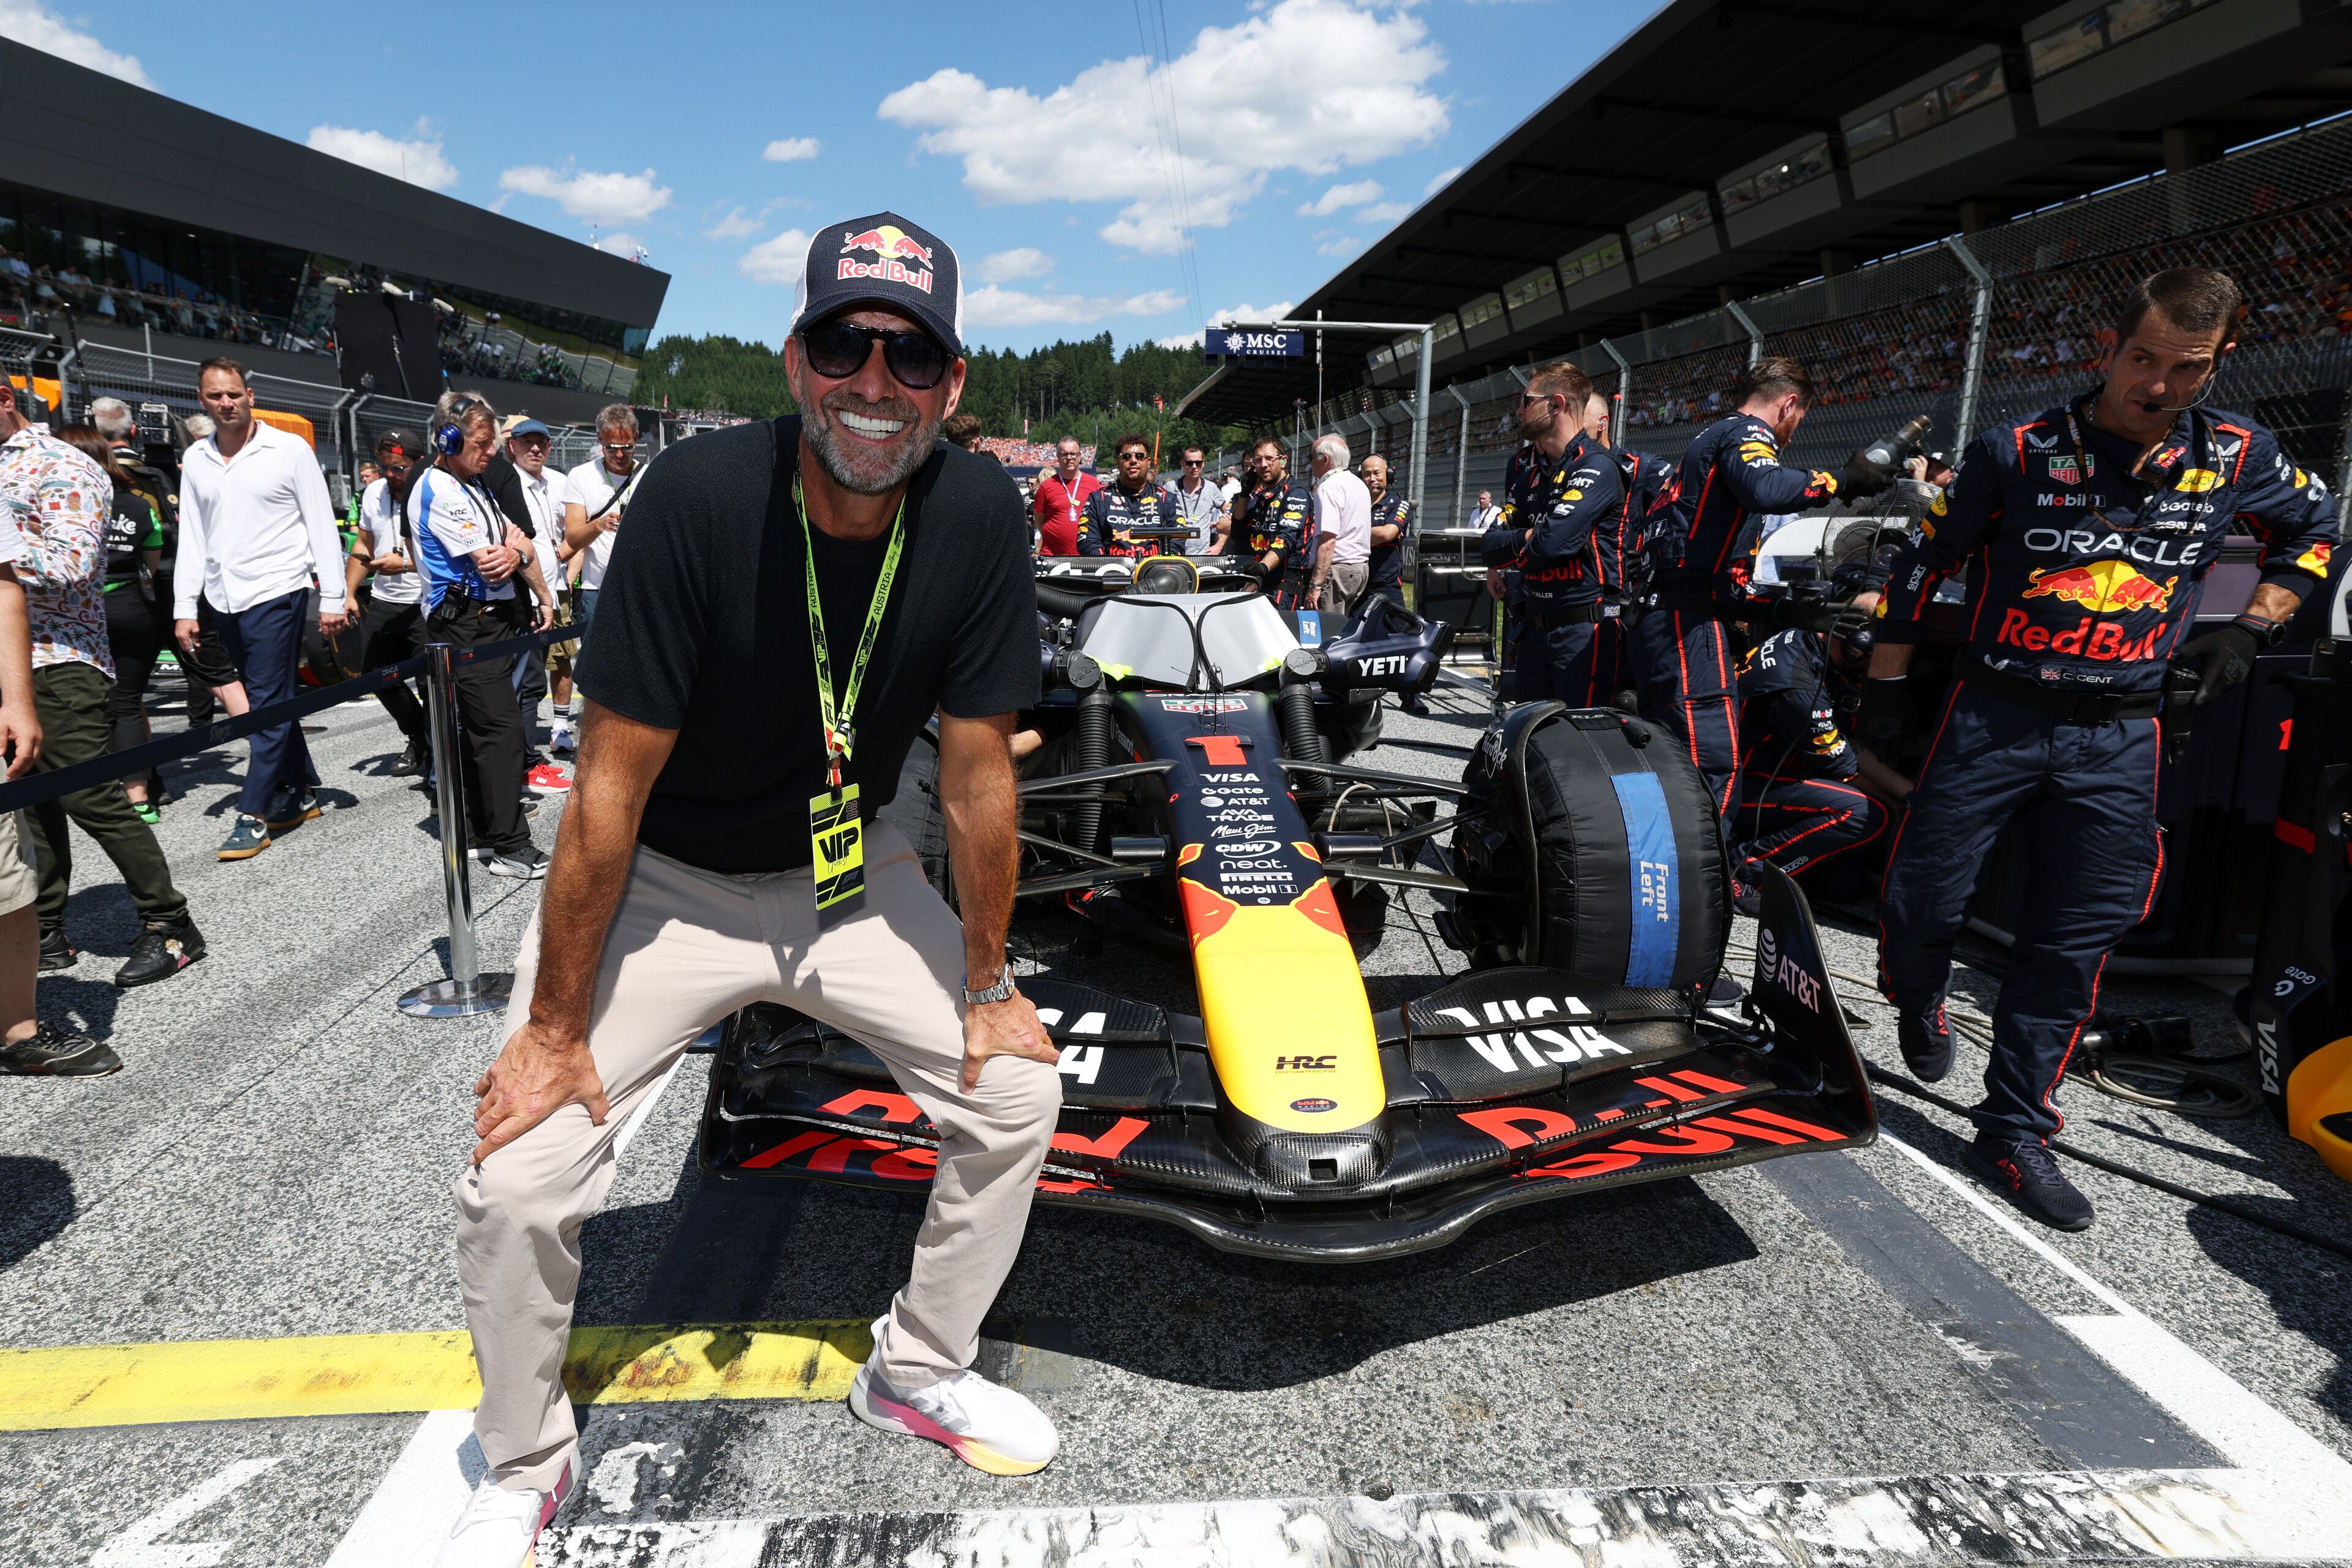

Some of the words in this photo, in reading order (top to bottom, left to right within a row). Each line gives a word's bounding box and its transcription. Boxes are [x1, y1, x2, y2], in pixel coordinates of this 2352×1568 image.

[838, 258, 886, 280] Red
[888, 260, 933, 294] Bull
[1246, 334, 1286, 349] MSC
[1804, 488, 1820, 497] Red
[2037, 493, 2086, 507] Mobil
[1107, 515, 1161, 526] ORACLE
[466, 537, 483, 546] NEFT
[2024, 528, 2203, 565] ORACLE
[808, 564, 818, 608] AUSTRIA
[873, 571, 892, 616] AUSTRIA
[813, 630, 824, 645] Guest
[1997, 607, 2092, 655] Red
[2086, 620, 2168, 662] Bull
[817, 643, 826, 664] VIP
[856, 648, 867, 667] VIP
[862, 635, 875, 654] Guest
[382, 666, 398, 676] ORACLE
[1357, 655, 1406, 677] YETI
[2063, 673, 2074, 681] C.
[2077, 674, 2113, 684] GENT
[2278, 718, 2293, 750] 1
[1184, 736, 1247, 765] 1
[1200, 773, 1260, 782] VISA
[1210, 825, 1243, 837] Maui
[1244, 823, 1277, 839] Jim
[818, 826, 859, 864] VIP
[1215, 842, 1266, 853] CDW
[827, 842, 851, 875] Guest
[1219, 860, 1287, 870] neat.
[1219, 872, 1293, 882] PIRELLI
[1640, 860, 1655, 907] Left
[1223, 885, 1277, 894] Mobil
[1655, 862, 1669, 923] Front
[1777, 954, 1821, 1014] AT&T
[2285, 966, 2316, 985] Gate
[1435, 997, 1633, 1073] VISA
[1276, 1056, 1337, 1069] HRC
[2257, 1018, 2280, 1096] VISA
